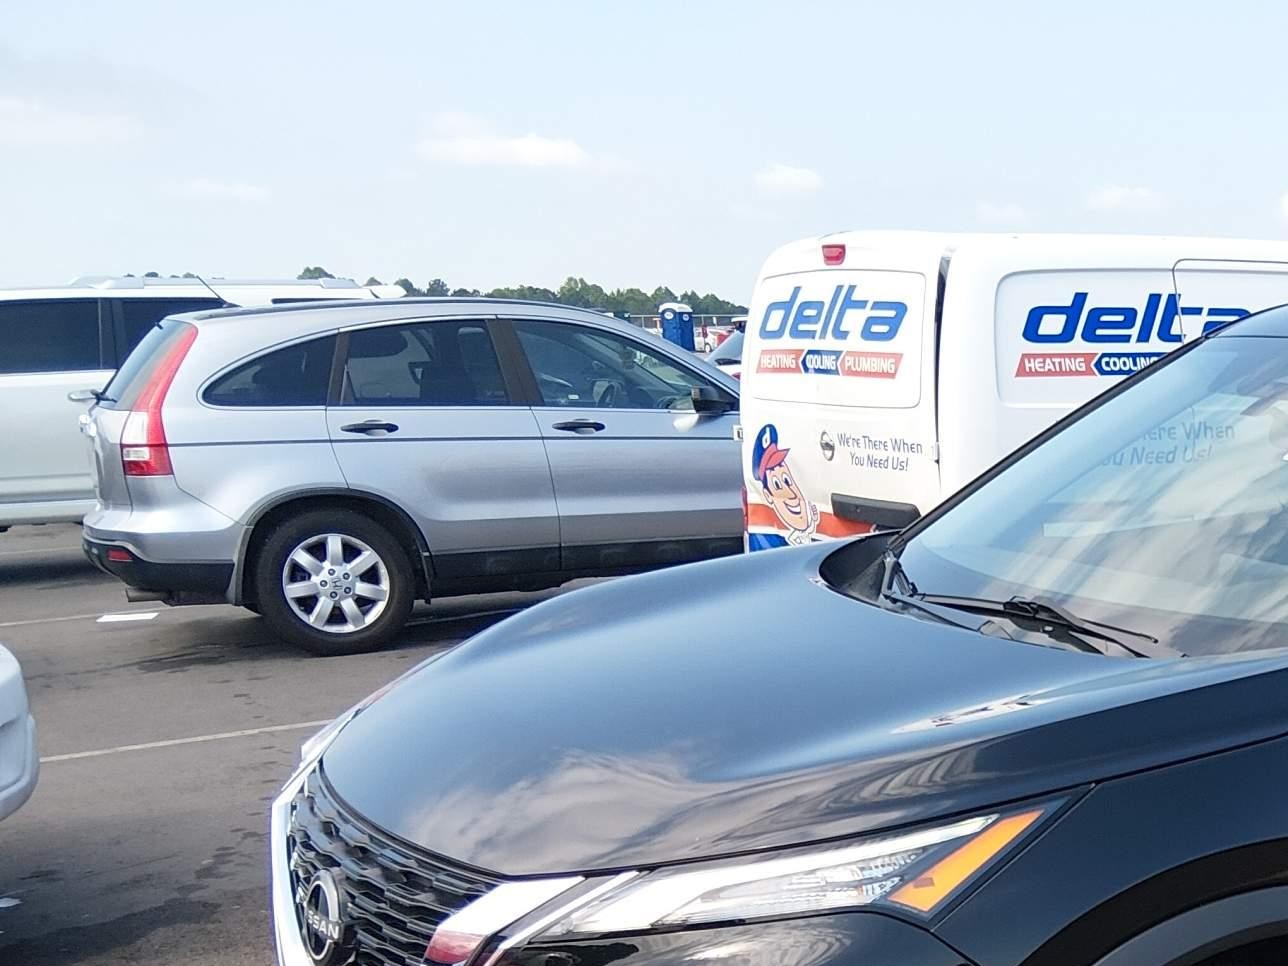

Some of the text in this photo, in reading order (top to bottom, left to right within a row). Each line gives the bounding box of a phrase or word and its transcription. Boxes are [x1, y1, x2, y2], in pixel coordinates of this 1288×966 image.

[759, 284, 908, 342] delta
[760, 353, 796, 369] HEATING
[845, 356, 896, 373] PLUMBING
[1024, 357, 1086, 372] HEATING
[1182, 420, 1236, 441] When
[837, 433, 923, 454] We're There When
[850, 452, 909, 472] You Need Us!
[1103, 451, 1124, 466] ou
[1129, 445, 1178, 465] Need
